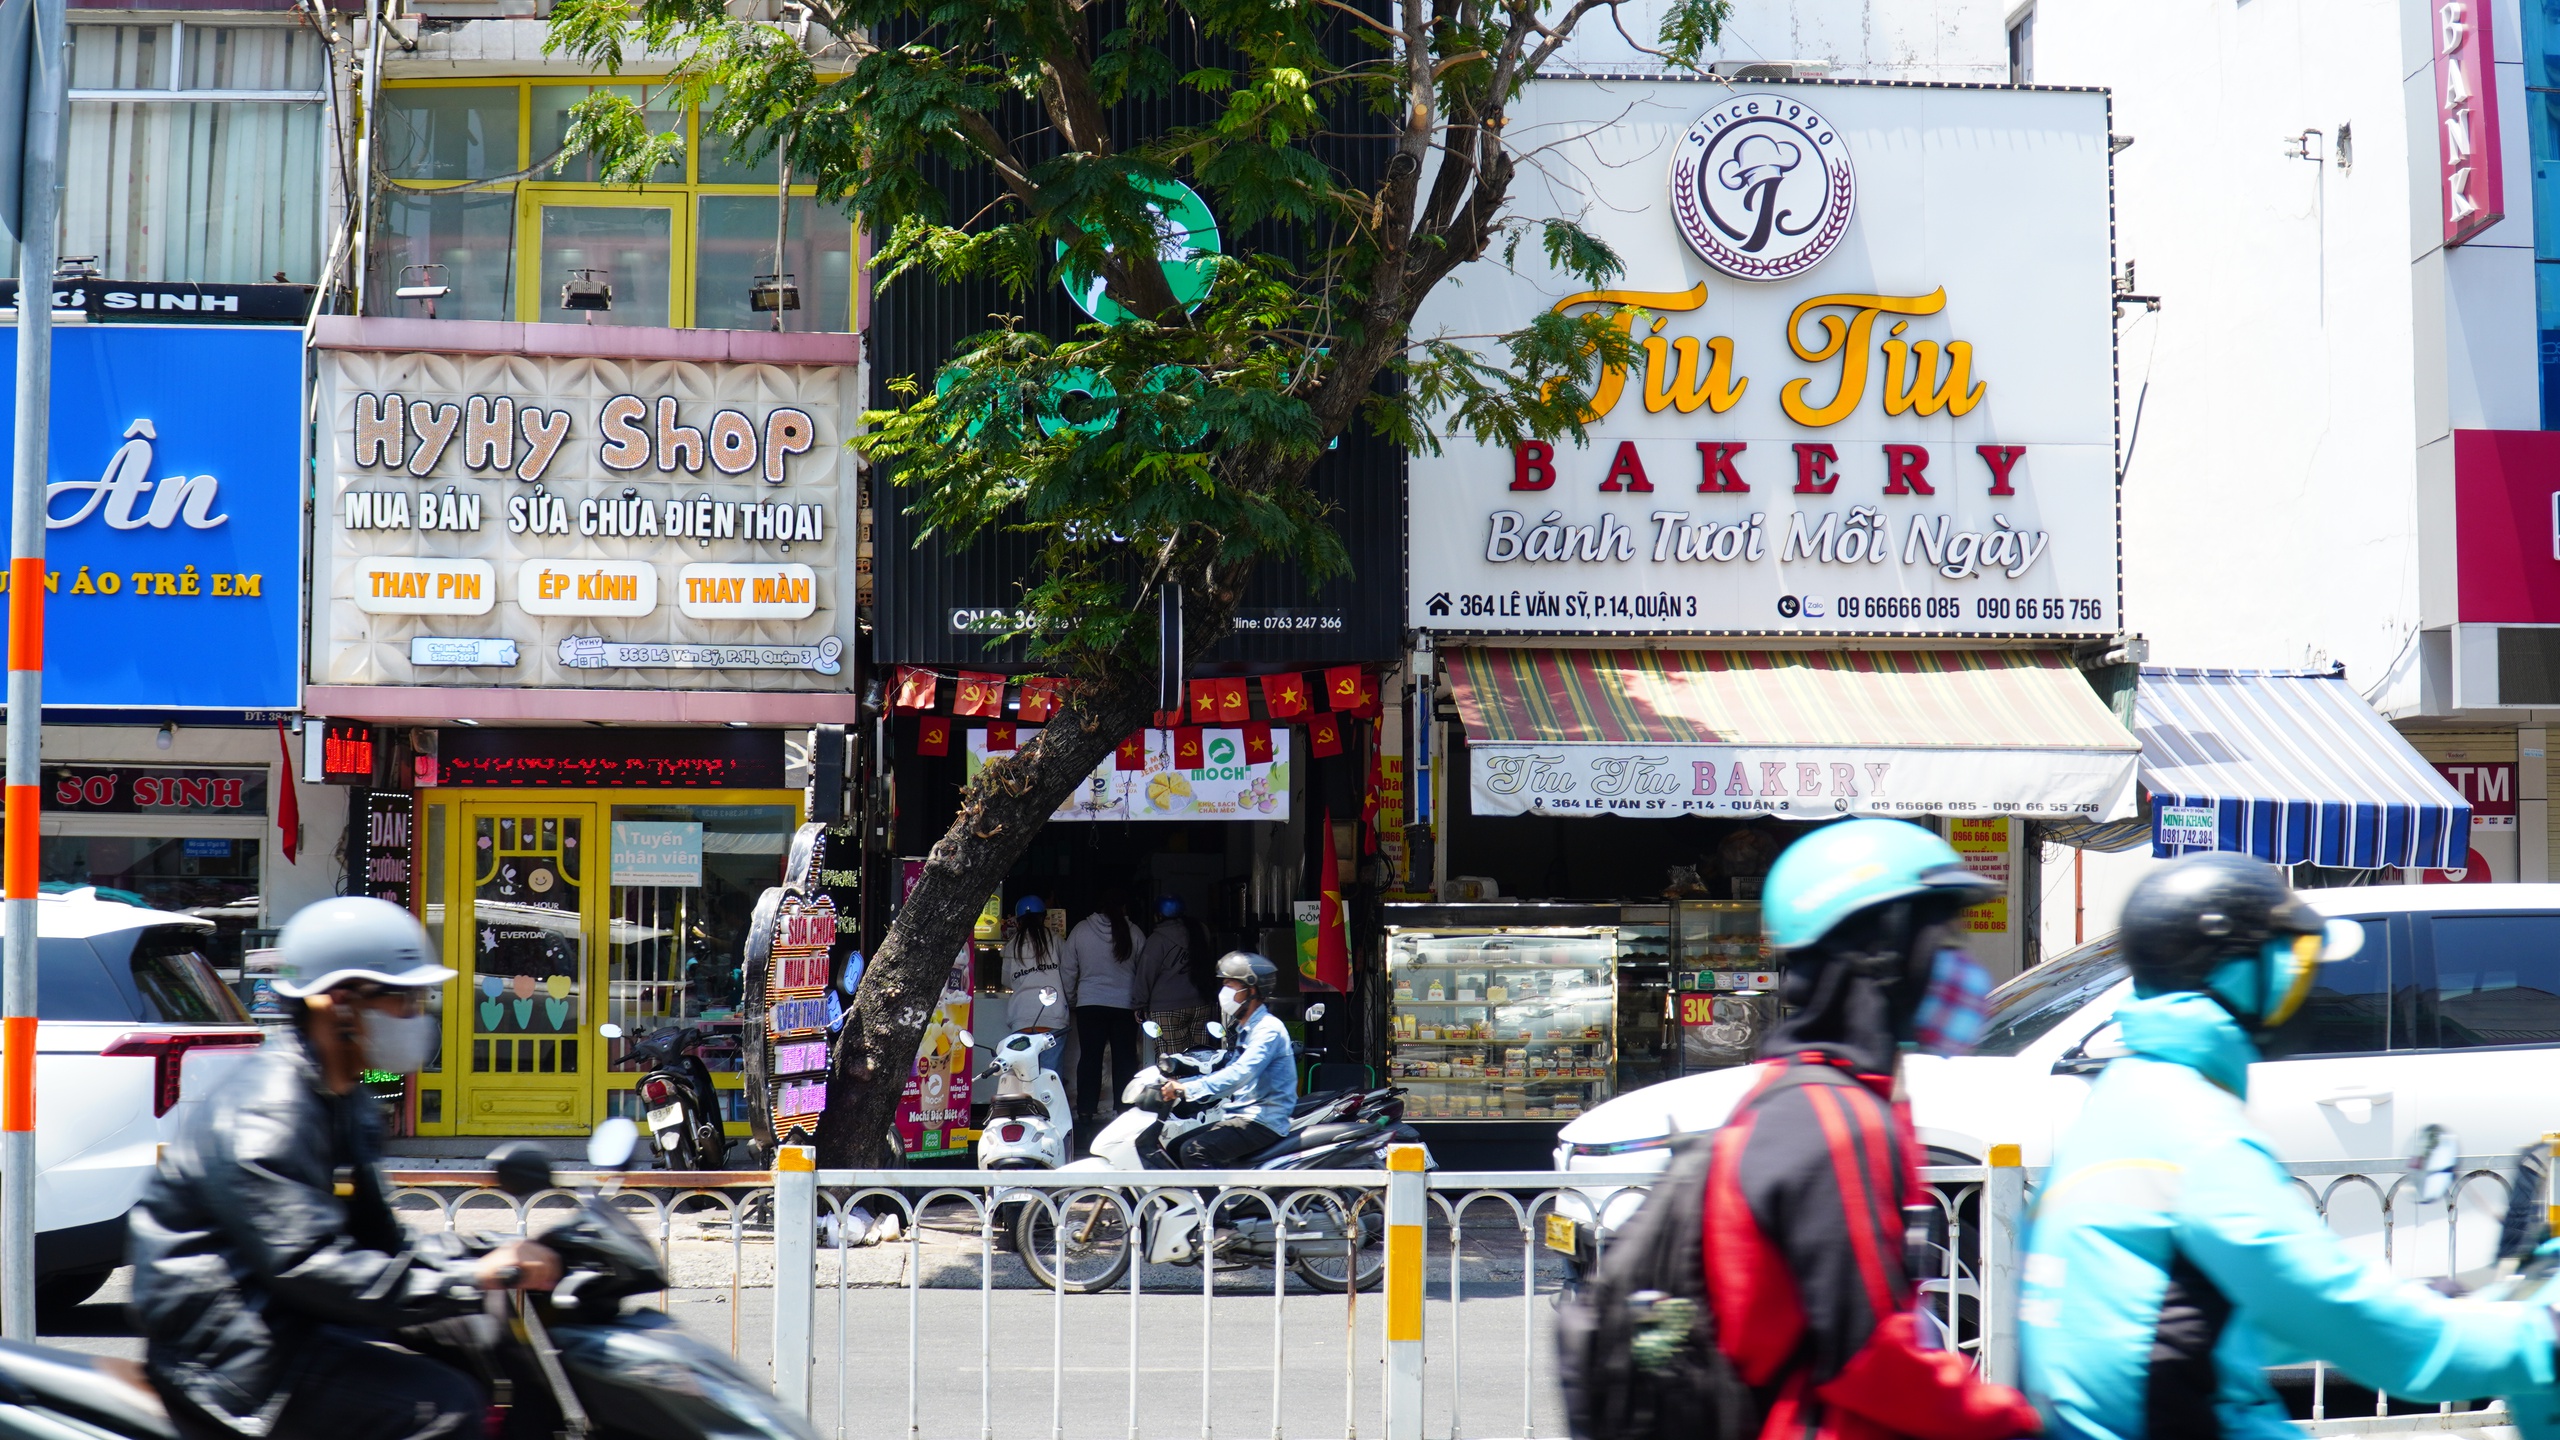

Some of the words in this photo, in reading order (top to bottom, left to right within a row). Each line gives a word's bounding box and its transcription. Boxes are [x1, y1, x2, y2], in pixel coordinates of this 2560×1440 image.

[1689, 102, 1760, 148] Since
[1775, 99, 1834, 146] 1990
[2439, 2, 2475, 223] BANK
[103, 291, 239, 312] SINH
[1780, 284, 1987, 427] Tíu
[45, 418, 229, 530] Ân
[1508, 440, 2027, 496] BAKERY
[345, 491, 411, 530] MUA
[418, 485, 481, 531] BÁN
[508, 482, 569, 534] SỬA
[579, 486, 659, 537] CHỮA
[664, 492, 735, 547] ĐIỆN
[740, 502, 824, 552] THOẠI
[1487, 508, 1636, 565] Bánh
[1651, 508, 1767, 563] Tươi
[1783, 505, 1889, 565] Mỗi
[1905, 512, 2050, 579] Ngày
[70, 566, 121, 595] ÁO
[131, 564, 200, 595] TRẺ
[211, 574, 262, 597] EM
[369, 571, 431, 599] THAY
[437, 573, 481, 600] PIN
[538, 568, 570, 600] ÉP
[577, 569, 637, 601] KÍNH
[686, 577, 746, 603] THAY
[752, 572, 810, 603] MÀN
[1460, 594, 1495, 617] 364
[1500, 590, 1521, 617] LÊ
[1526, 590, 1560, 617] VĂN
[1566, 590, 1591, 619] SỸ,
[1686, 595, 1697, 617] 3
[1838, 596, 1860, 618] 09
[1865, 597, 1922, 619] 66666
[1927, 597, 1960, 619] 085
[1977, 597, 2010, 619] 090
[2016, 597, 2038, 619] 66
[2043, 598, 2064, 619] 55
[2070, 598, 2102, 620] 756
[1264, 617, 1292, 629] 0763
[1295, 617, 1317, 629] 247
[1320, 617, 1342, 629] 366
[430, 653, 457, 663] Since
[458, 653, 479, 663] 2011
[619, 647, 649, 662] 366
[651, 646, 670, 663] Lê
[673, 648, 699, 663] Văn
[762, 651, 799, 666] Quận
[801, 651, 811, 664] 3
[1486, 753, 1577, 795] Tíu
[1591, 755, 1681, 796] Tíu
[1692, 760, 1891, 797] BAKERY
[2448, 767, 2509, 802] TM
[56, 773, 118, 805] SƠ
[133, 777, 244, 807] SINH
[1551, 798, 1580, 809] 364
[1586, 797, 1603, 809] LÊ
[1609, 798, 1643, 809] VĂN
[1647, 798, 1666, 810] SỸ
[1683, 800, 1714, 810] P.14
[1731, 799, 1775, 812] QUẬN
[1780, 801, 1789, 811] 3
[1871, 801, 1890, 811] 09
[1895, 802, 1943, 811] 66666
[1949, 802, 1977, 811] 085
[1993, 802, 2020, 812] 090
[2026, 802, 2044, 812] 66
[2050, 803, 2068, 812] 55
[2073, 803, 2099, 813] 756
[371, 804, 408, 848] DÁN
[2163, 814, 2184, 827] MINH
[2186, 815, 2213, 828] KHANG
[630, 830, 683, 848] Tuyển
[1953, 831, 1972, 841] 0966
[1975, 832, 1989, 841] 666
[1992, 832, 2007, 842] 085
[369, 853, 407, 882] CƯỜNG
[614, 850, 657, 865] nhân
[662, 850, 699, 865] viên
[533, 901, 560, 910] HOUR
[500, 931, 547, 939] EVERYDAY
[1974, 921, 1988, 930] 666
[1991, 921, 2006, 930] 085
[784, 959, 805, 988] MUA
[898, 1006, 928, 1030] 32
[1684, 998, 1712, 1023] 3K
[925, 1132, 939, 1140] Grab
